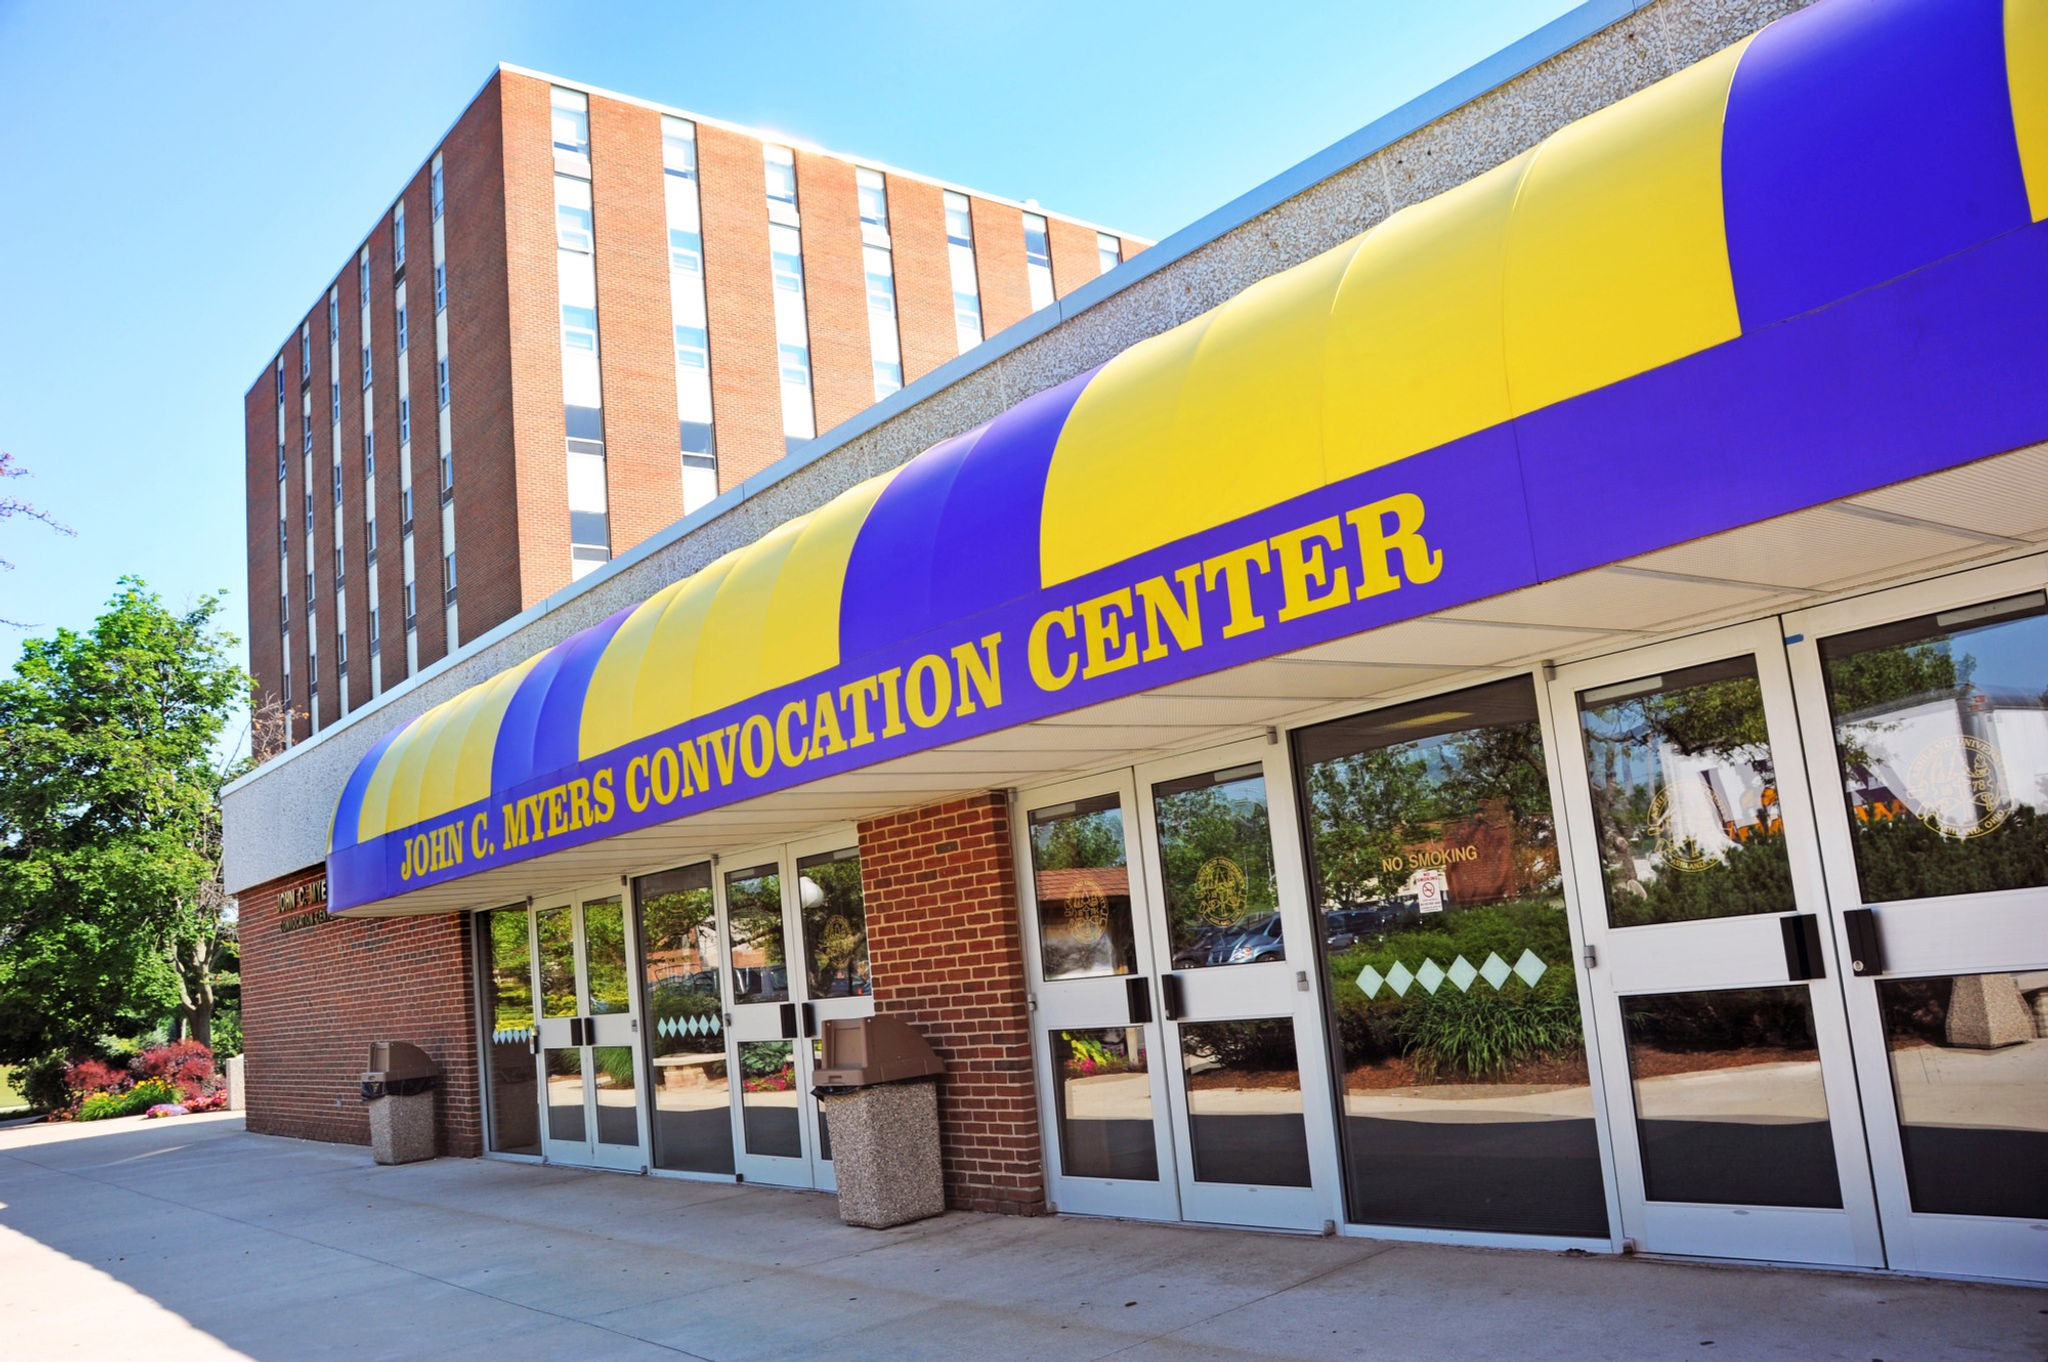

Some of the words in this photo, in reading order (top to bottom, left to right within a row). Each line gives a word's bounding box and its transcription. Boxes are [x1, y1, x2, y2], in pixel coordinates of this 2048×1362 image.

[401, 820, 464, 881] JOHN
[471, 811, 495, 859] C.
[503, 767, 616, 850] MYERS
[625, 632, 1002, 813] CONVOCATION
[1027, 492, 1443, 691] CENTER
[1984, 809, 2006, 829] OHIO
[1382, 857, 1403, 872] NO
[1408, 845, 1478, 869] SMOKING
[276, 889, 296, 912] JOHN
[309, 880, 327, 904] MYE
